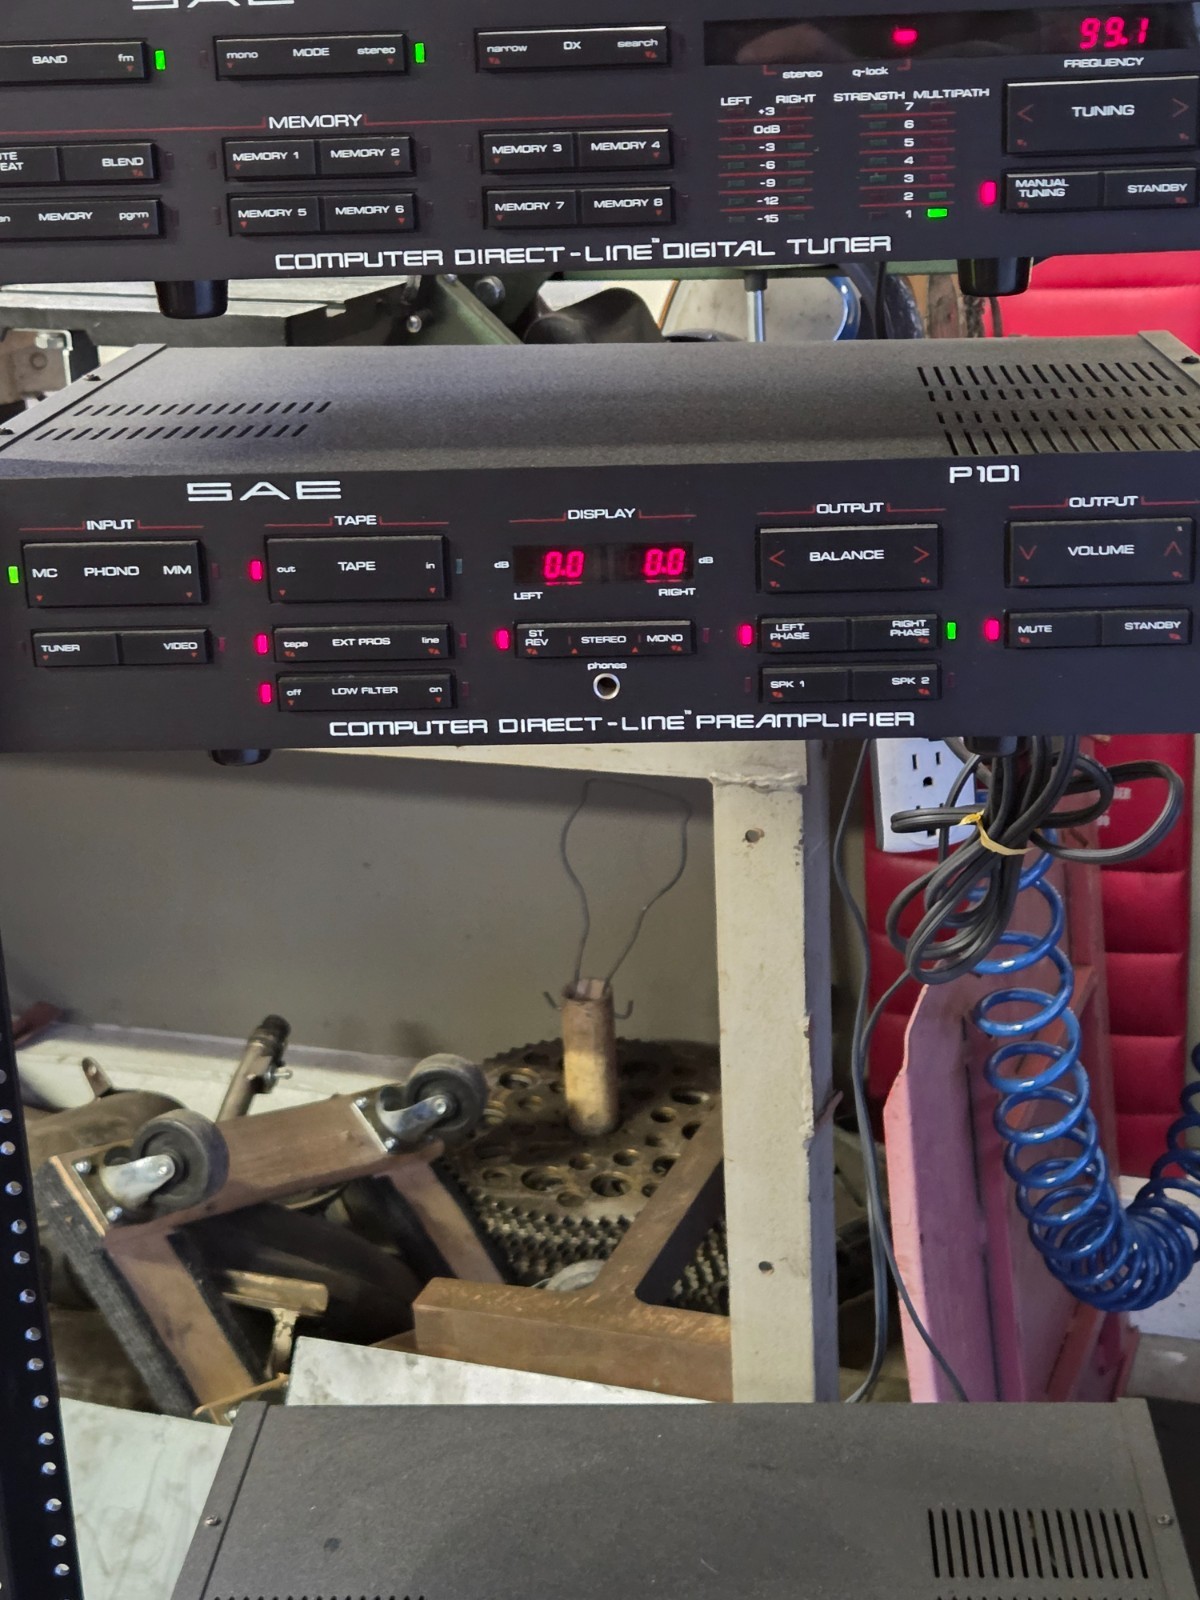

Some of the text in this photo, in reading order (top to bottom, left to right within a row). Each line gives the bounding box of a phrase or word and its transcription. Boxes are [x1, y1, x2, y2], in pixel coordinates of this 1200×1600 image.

[1079, 16, 1150, 51] 99.1
[563, 40, 582, 51] DX
[616, 38, 659, 48] search
[292, 47, 330, 57] MODE
[356, 46, 397, 55] stereo
[486, 45, 528, 53] narrow
[31, 54, 68, 65] BAND
[117, 53, 135, 62] fm
[226, 51, 259, 60] mono
[1063, 56, 1145, 69] FREQUENCY
[782, 70, 824, 80] stereo
[851, 66, 889, 78] q-lock
[775, 93, 817, 104] RIGHT
[833, 90, 906, 103] STRENGTH
[912, 87, 990, 100] MULTIPATH
[720, 95, 753, 107] LEFT
[904, 101, 915, 111] 7
[1071, 104, 1135, 118] TUNING
[268, 113, 363, 130] MEMORY
[903, 119, 915, 129] 6
[590, 140, 661, 151] MEMORY 4
[758, 142, 776, 152] -3
[903, 137, 915, 148] 5
[330, 147, 401, 159] MEMORY 2
[491, 143, 563, 155] MEMORY 3
[232, 151, 288, 162] MEMORY
[903, 155, 914, 165] 4
[101, 156, 144, 168] BLEND
[759, 160, 776, 170] -6
[759, 178, 776, 188] -9
[903, 173, 914, 183] 3
[1015, 178, 1070, 188] MANUAL
[1018, 187, 1066, 198] TUNING
[1127, 183, 1188, 194] STANDBY
[756, 196, 779, 206] -12
[903, 191, 914, 201] 2
[494, 201, 565, 212] MEMORY 7
[593, 197, 664, 209] MEMORY 8
[237, 207, 308, 219] MEMORY 5
[334, 204, 405, 216] MEMORY 6
[38, 211, 93, 222] MEMORY
[118, 211, 150, 221] pgrm
[756, 213, 780, 223] -15
[274, 249, 444, 271] COMPUTER
[662, 239, 776, 260] DIGITAL
[786, 235, 892, 255] TUNER
[949, 464, 1020, 484] P101
[186, 480, 342, 502] SAE
[1068, 495, 1139, 508] OUTPUT
[815, 501, 885, 515] OUTPUT
[567, 507, 636, 520] DISPLAY
[86, 518, 135, 531] INPUT
[333, 514, 378, 526] TAPE
[809, 549, 885, 562] BALANCE
[1067, 544, 1135, 557] VOLUME
[425, 561, 436, 570] in
[493, 560, 510, 569] dB
[543, 550, 585, 580] 0.0
[642, 547, 686, 577] 0.0
[698, 556, 714, 565] dB
[83, 565, 140, 577] PHONO
[162, 564, 192, 575] MM
[276, 565, 297, 573] out
[337, 560, 377, 572] TAPE
[31, 567, 59, 578] MC
[513, 591, 544, 601] LEFT
[658, 587, 697, 597] RIGHT
[775, 622, 806, 632] LEFT
[891, 619, 927, 628] RIGHT
[1124, 620, 1182, 631] STANDBY
[528, 629, 545, 638] ST
[889, 627, 930, 637] PHASE
[1017, 624, 1053, 634] MUTE
[421, 636, 440, 644] line
[580, 635, 627, 644] STEREO
[646, 633, 684, 643] MONO
[769, 631, 810, 641] PHASE
[162, 641, 198, 650] VIDEO
[283, 641, 309, 650] tape
[331, 637, 391, 647] EXT PROS
[524, 638, 549, 647] REV
[40, 643, 81, 653] TUNER
[586, 661, 628, 671] phones
[770, 680, 795, 689] SPK
[891, 676, 930, 686] SPK 2
[286, 688, 302, 697] off
[331, 686, 399, 696] LOW FILTER
[329, 718, 489, 737] COMPUTER
[695, 711, 915, 730] PREAMPLIFIER
